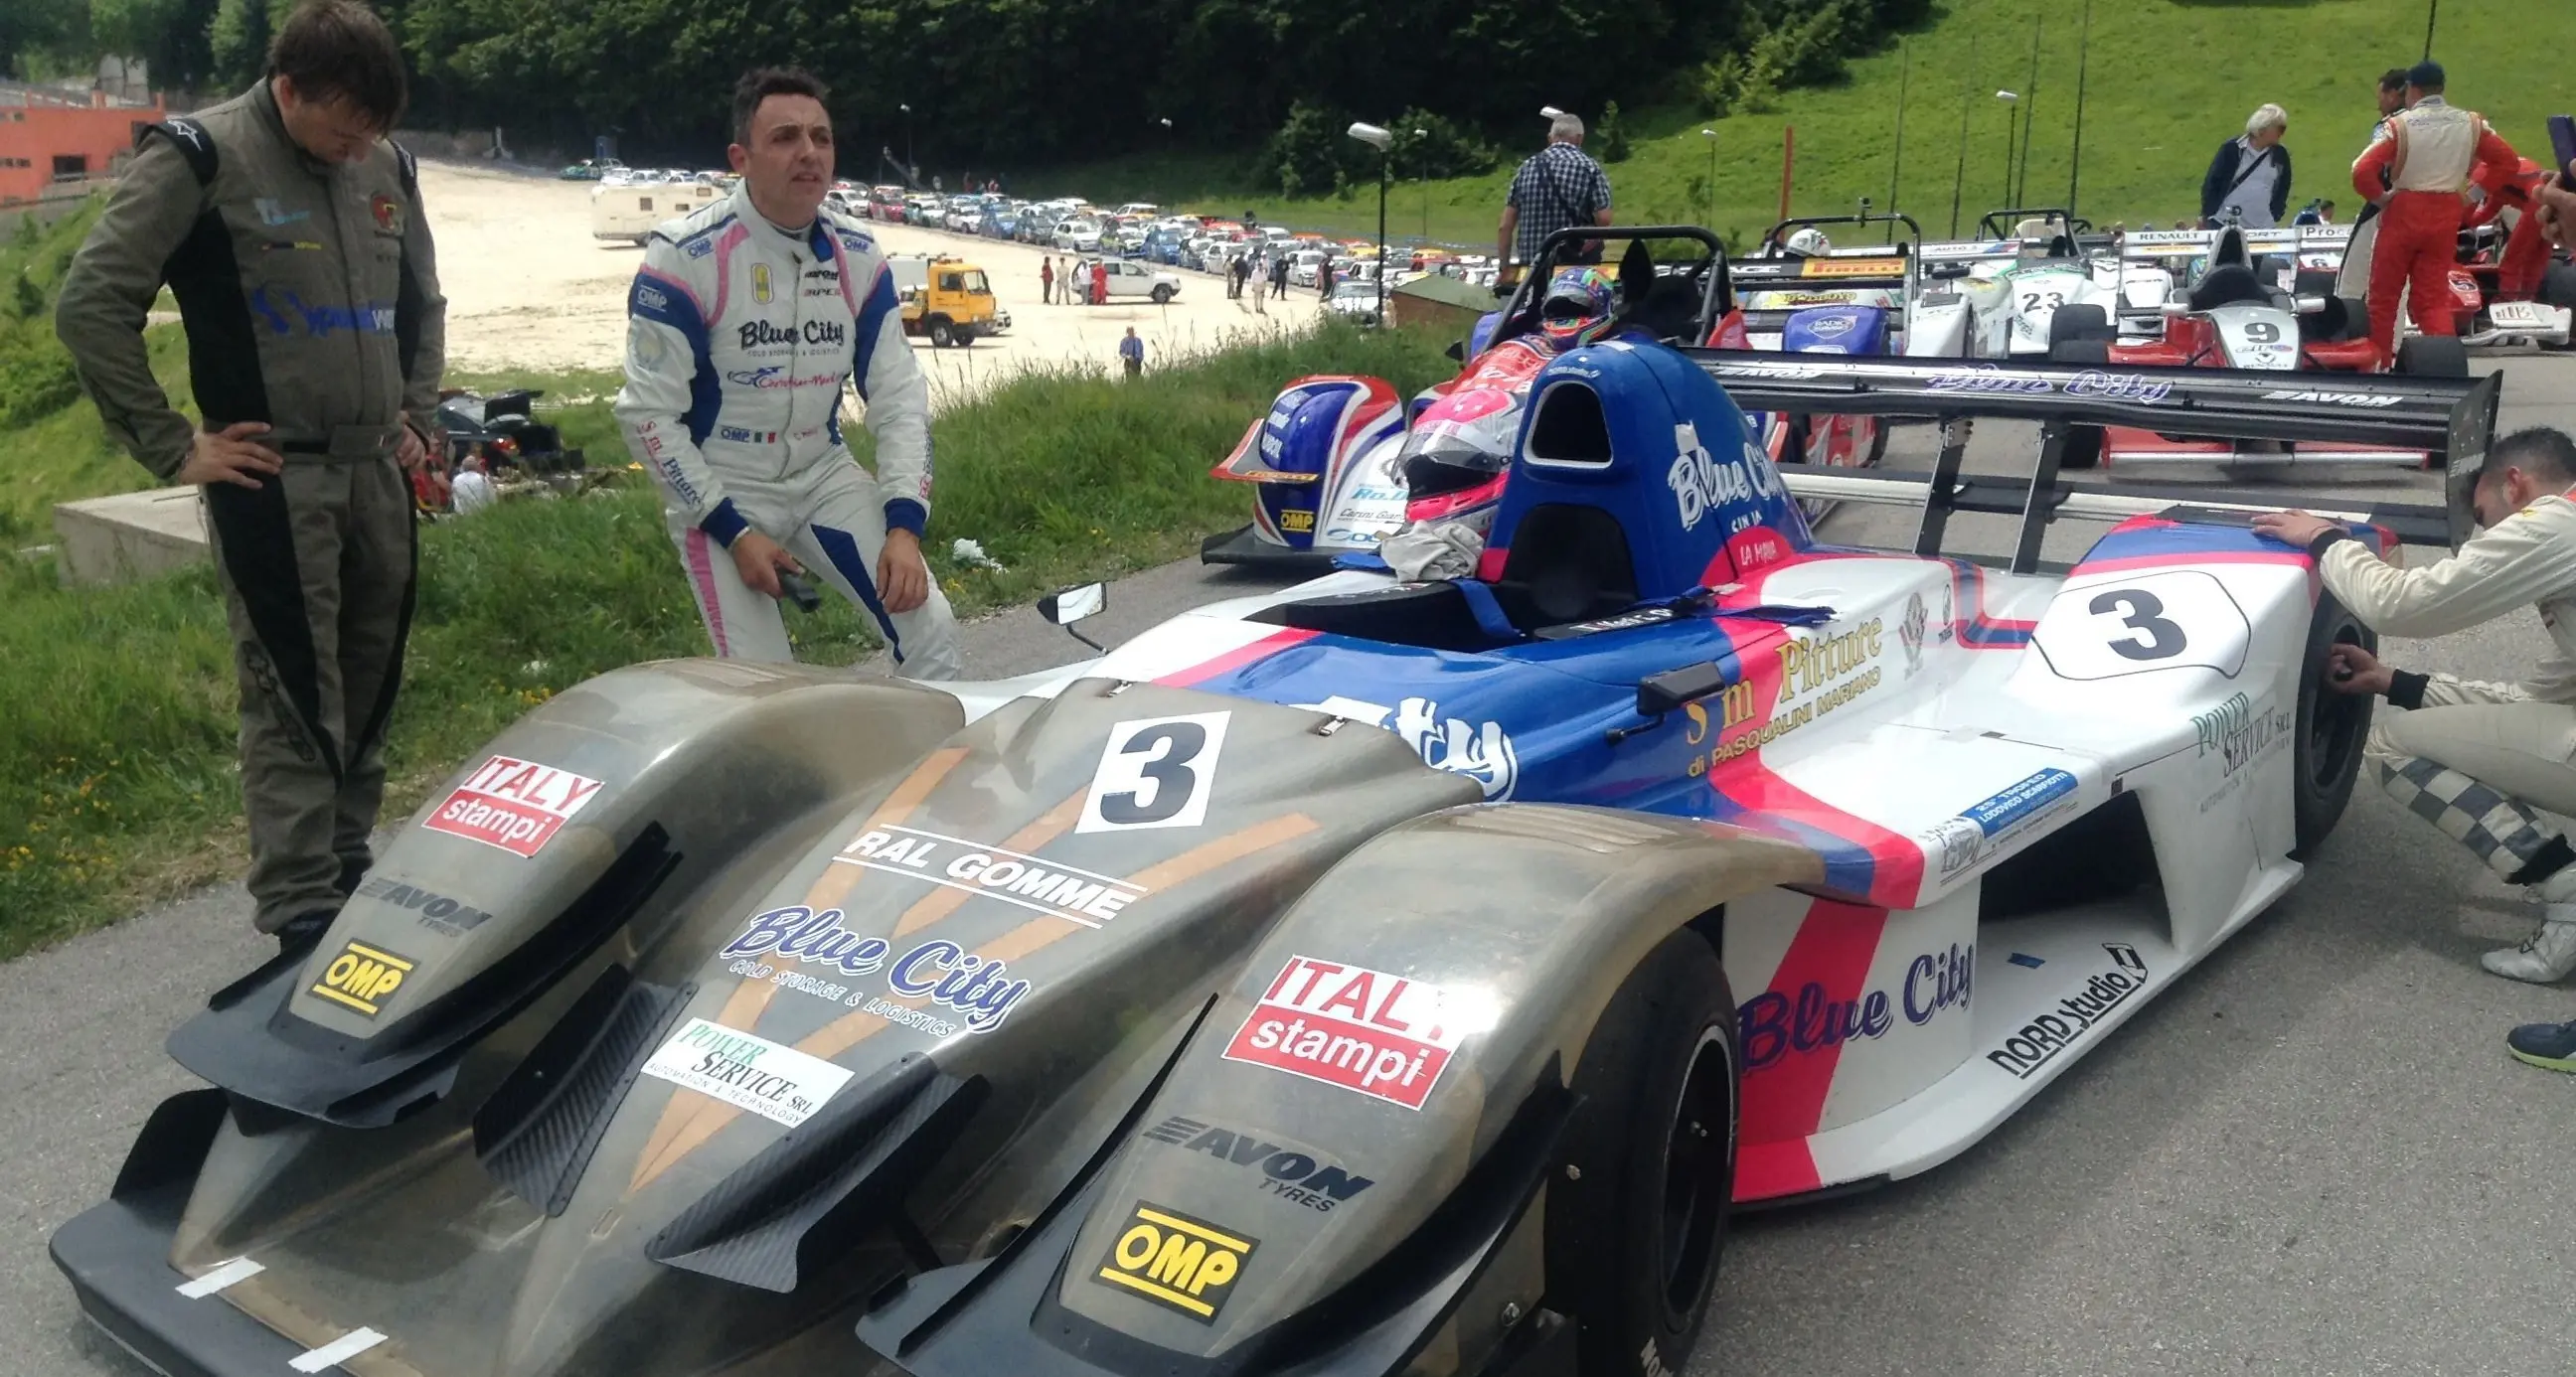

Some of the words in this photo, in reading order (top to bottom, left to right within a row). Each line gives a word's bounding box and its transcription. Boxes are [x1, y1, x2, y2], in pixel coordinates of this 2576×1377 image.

[638, 289, 667, 308] OMP
[2022, 291, 2065, 314] 23
[738, 319, 801, 350] Blue
[803, 320, 845, 347] City
[2244, 322, 2281, 344] 9
[2290, 391, 2403, 407] AVON
[1668, 446, 1752, 532] Blue
[1280, 512, 1315, 530] OMP
[2089, 589, 2187, 661] 3
[1775, 617, 1883, 703] Pitture
[1688, 754, 1706, 778] di
[1711, 703, 1813, 767] PASQUALINI
[1817, 667, 1881, 717] MARIANO
[464, 757, 603, 811] ITALY
[1099, 722, 1206, 824] 3
[443, 799, 550, 844] stampi
[382, 883, 494, 931] AVON
[851, 832, 928, 869] RAL
[946, 854, 1136, 920] GOMME
[325, 954, 403, 1000] OMP
[720, 905, 890, 976] Blue
[887, 939, 1031, 1034] City
[728, 960, 772, 979] COLD
[771, 970, 848, 1000] STORAGE
[845, 992, 860, 1006] &
[863, 997, 956, 1037] LOGISTICS
[1265, 956, 1461, 1040] ITAL
[2064, 970, 2132, 1029] studio
[1737, 982, 1893, 1076] Blue
[1903, 943, 1975, 1026] City
[679, 1024, 768, 1066] POWER
[1249, 1015, 1430, 1089] stampi
[650, 1063, 709, 1089] AUTOMATION
[728, 1089, 803, 1124] TECHNOLOGY
[691, 1050, 797, 1102] SERVICE
[786, 1095, 814, 1115] SRL
[1188, 1130, 1376, 1202] AVON
[1258, 1176, 1336, 1214] TYRES
[1115, 1223, 1239, 1294] OMP
